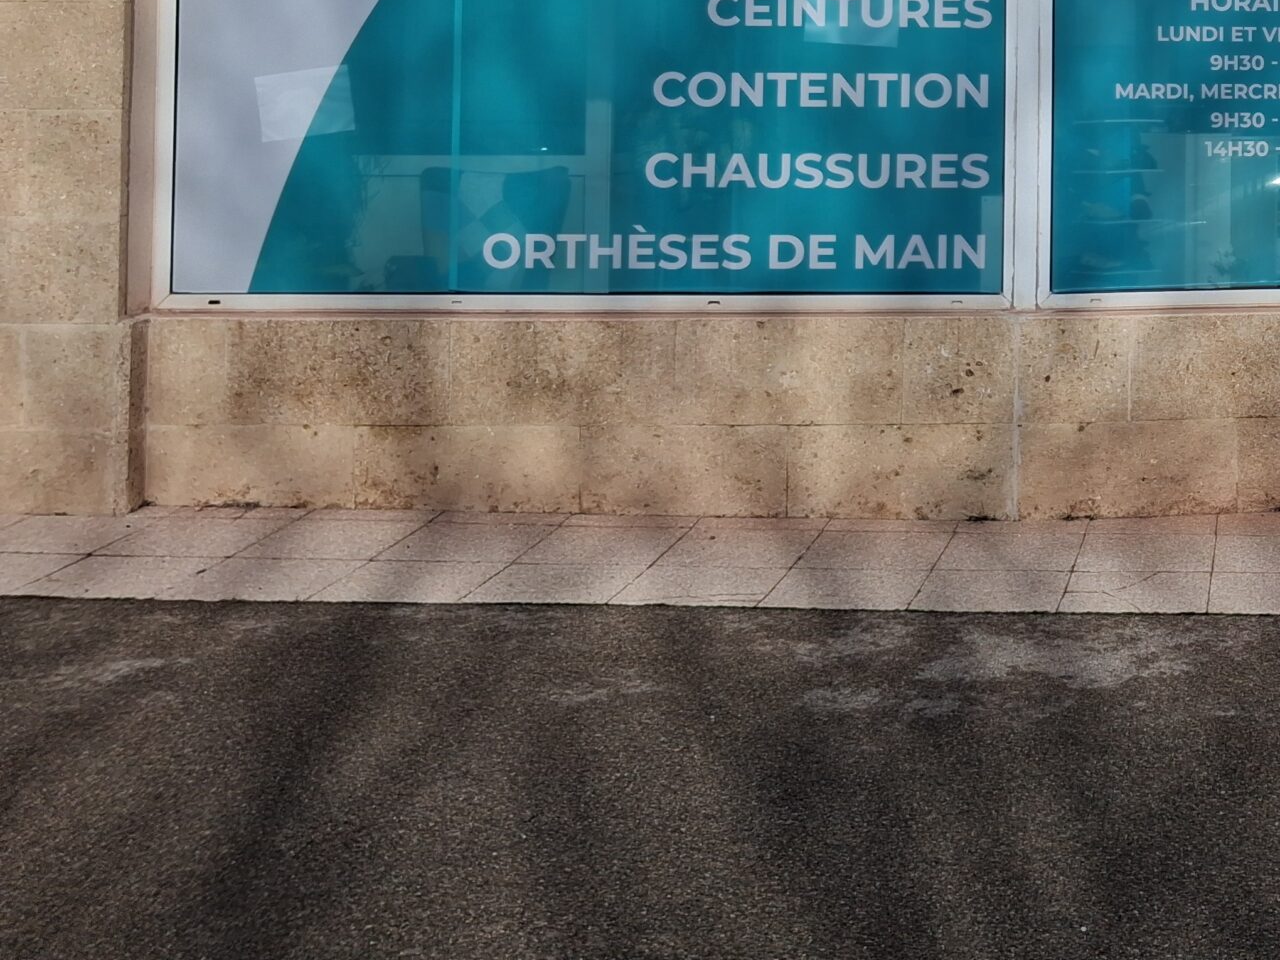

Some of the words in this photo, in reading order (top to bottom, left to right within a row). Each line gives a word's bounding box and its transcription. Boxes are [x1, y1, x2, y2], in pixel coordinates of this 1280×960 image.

[1157, 25, 1224, 42] LUNDI
[1231, 26, 1257, 43] ET
[1209, 54, 1265, 71] 9H30
[653, 71, 989, 109] CONTENTION
[1115, 82, 1194, 102] MARDI,
[1210, 111, 1266, 129] 9H30
[1204, 140, 1269, 158] 14H30
[645, 152, 990, 189] CHAUSSURES
[482, 224, 752, 271] ORTHÈSES
[768, 234, 837, 270] DE
[854, 233, 987, 270] MAIN
